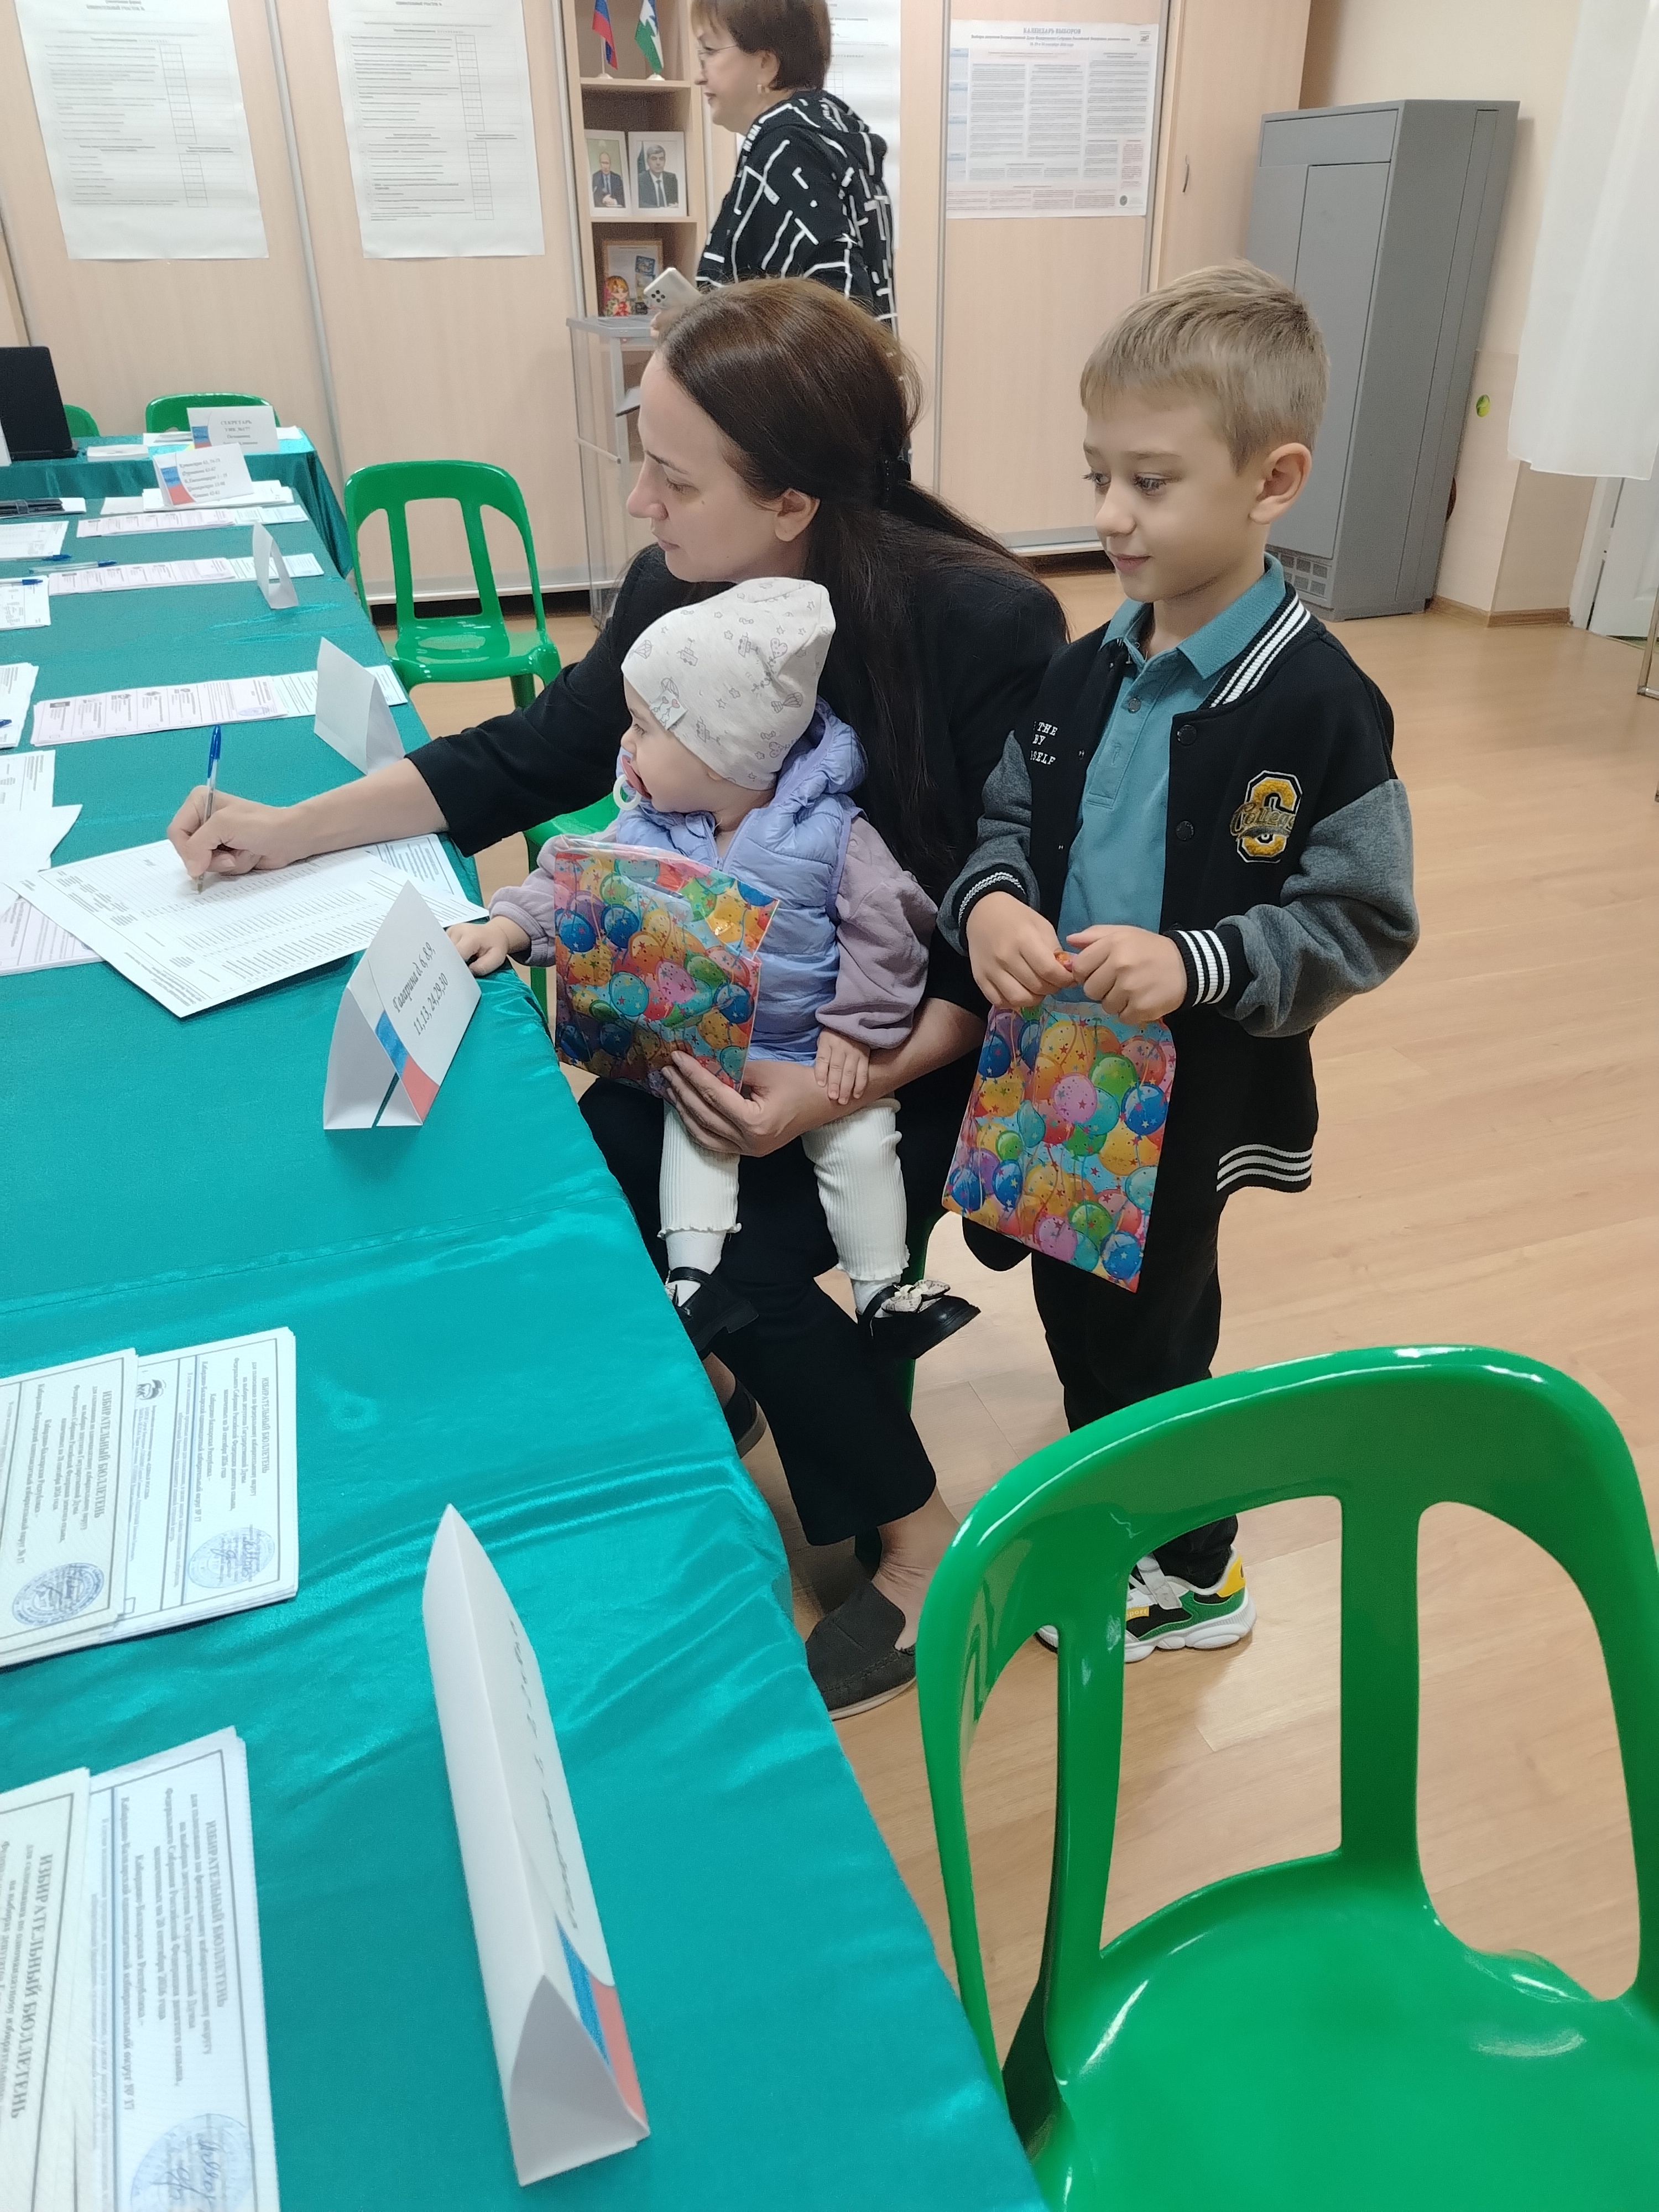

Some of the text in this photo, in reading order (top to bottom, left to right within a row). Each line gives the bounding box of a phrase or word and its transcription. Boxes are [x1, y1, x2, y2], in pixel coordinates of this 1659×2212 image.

[1032, 734, 1046, 745] BY
[1037, 722, 1058, 736] THE
[393, 971, 419, 1013] Гагарина
[94, 1390, 112, 1518] ИЗБИРАТЕЛЬНЫЙ БЮЛЛЕТЕНЬ
[261, 1377, 270, 1474] ИЗБИРАТЕЛЬНЫЙ БЮЛЛЕТЕНЬ
[206, 1820, 227, 2007] ИЗБИРАТЕЛЬНЫЙ БЮЛЛЕТЕНЬ
[11, 1854, 52, 2119] ИЗБИРАТЕЛЬНЫЙ БЮЛЛЕТЕНЬ
